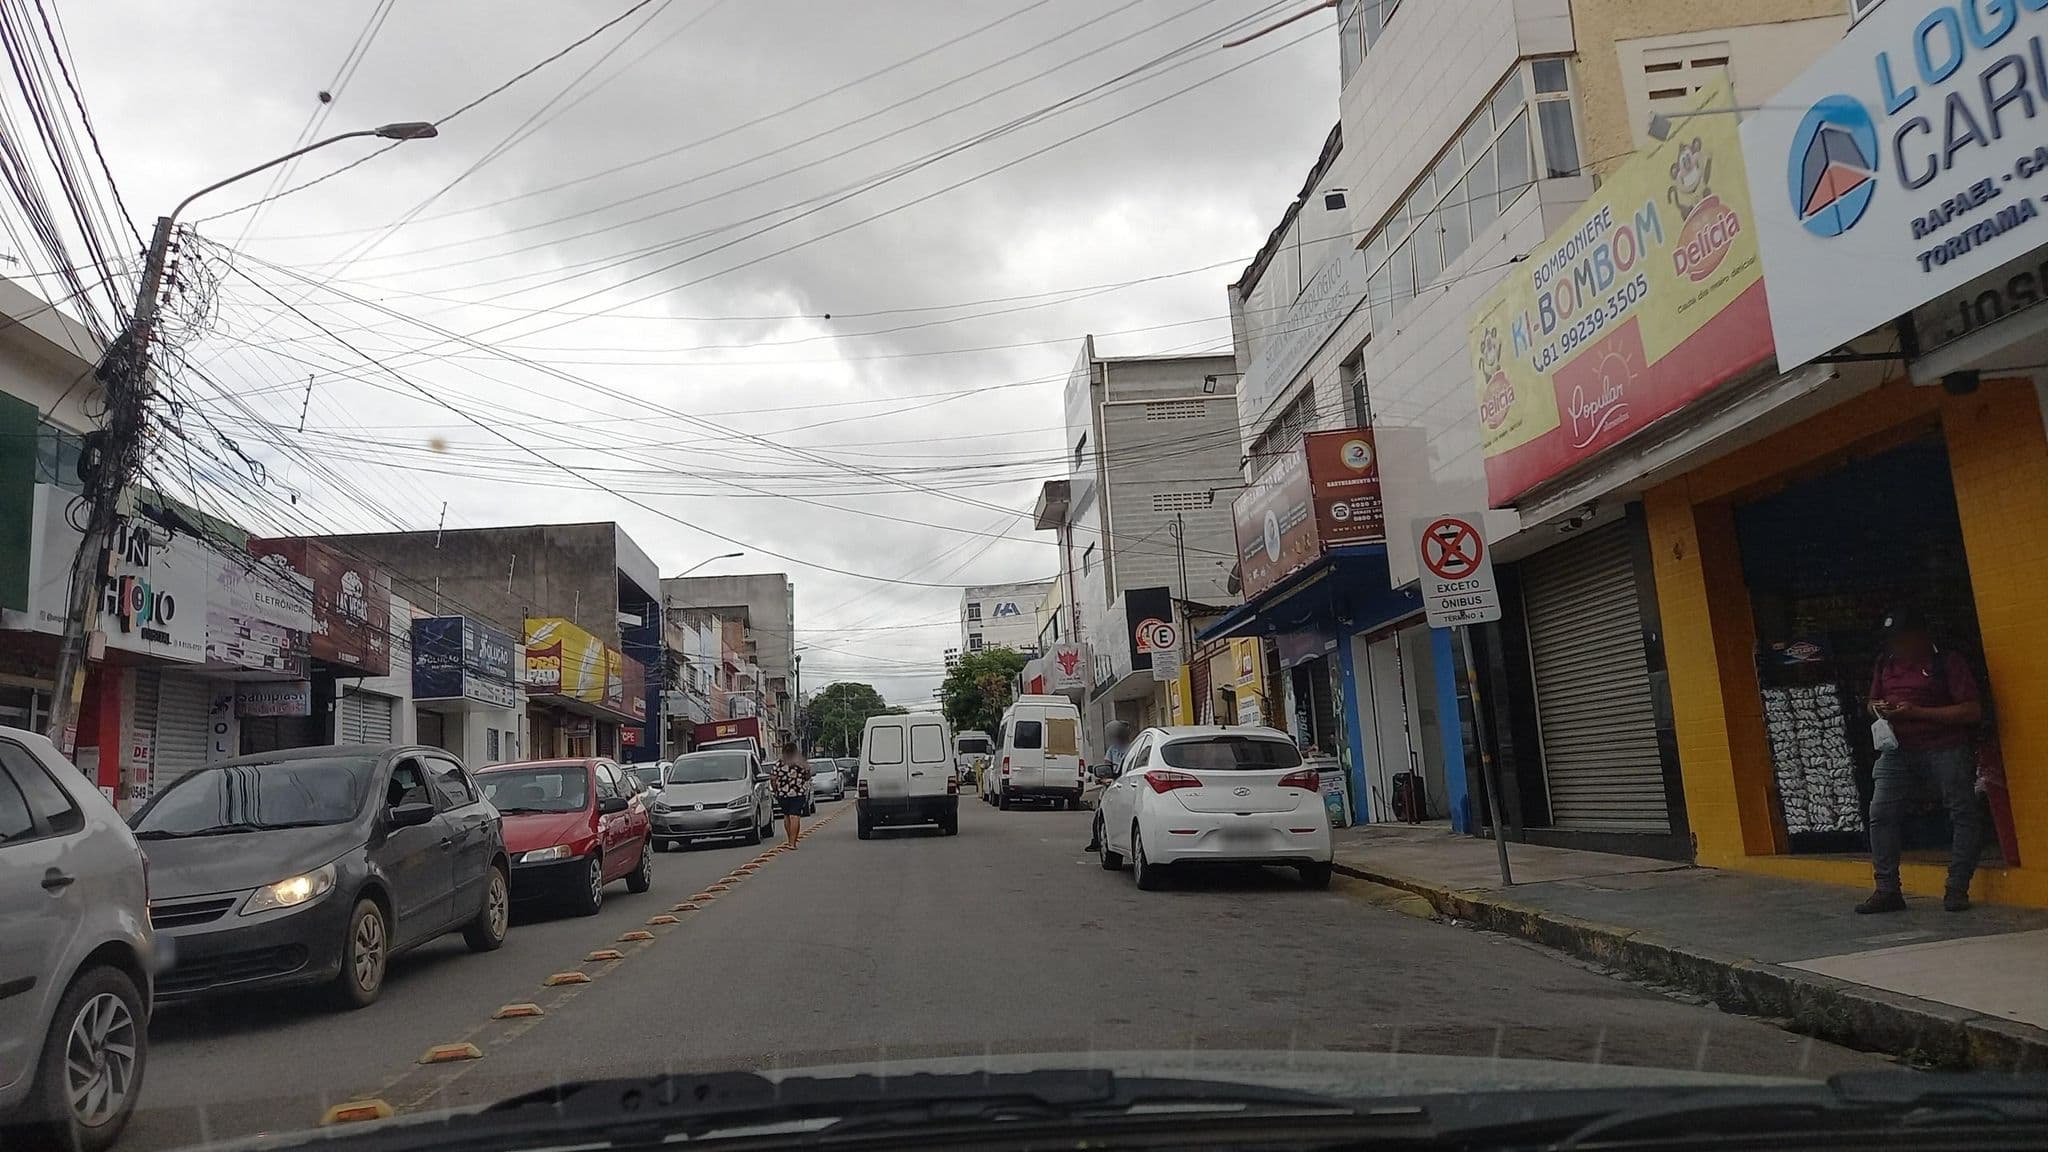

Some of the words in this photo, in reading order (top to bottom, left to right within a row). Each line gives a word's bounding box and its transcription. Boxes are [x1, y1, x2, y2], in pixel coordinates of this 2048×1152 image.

[1875, 0, 2048, 116] LOG
[1911, 177, 2002, 240] RAFAEL
[1916, 198, 2038, 272] TORITAMA
[1533, 205, 1612, 290] BOMBONIERE
[1672, 211, 1741, 277] Delícia
[1511, 200, 1664, 358] KI-BOMBOM
[1562, 274, 1649, 353] 99239-3505
[1568, 375, 1624, 438] Popular
[1437, 580, 1479, 593] EXCETO
[1441, 595, 1482, 609] ÔNIBUS
[1159, 629, 1169, 644] E
